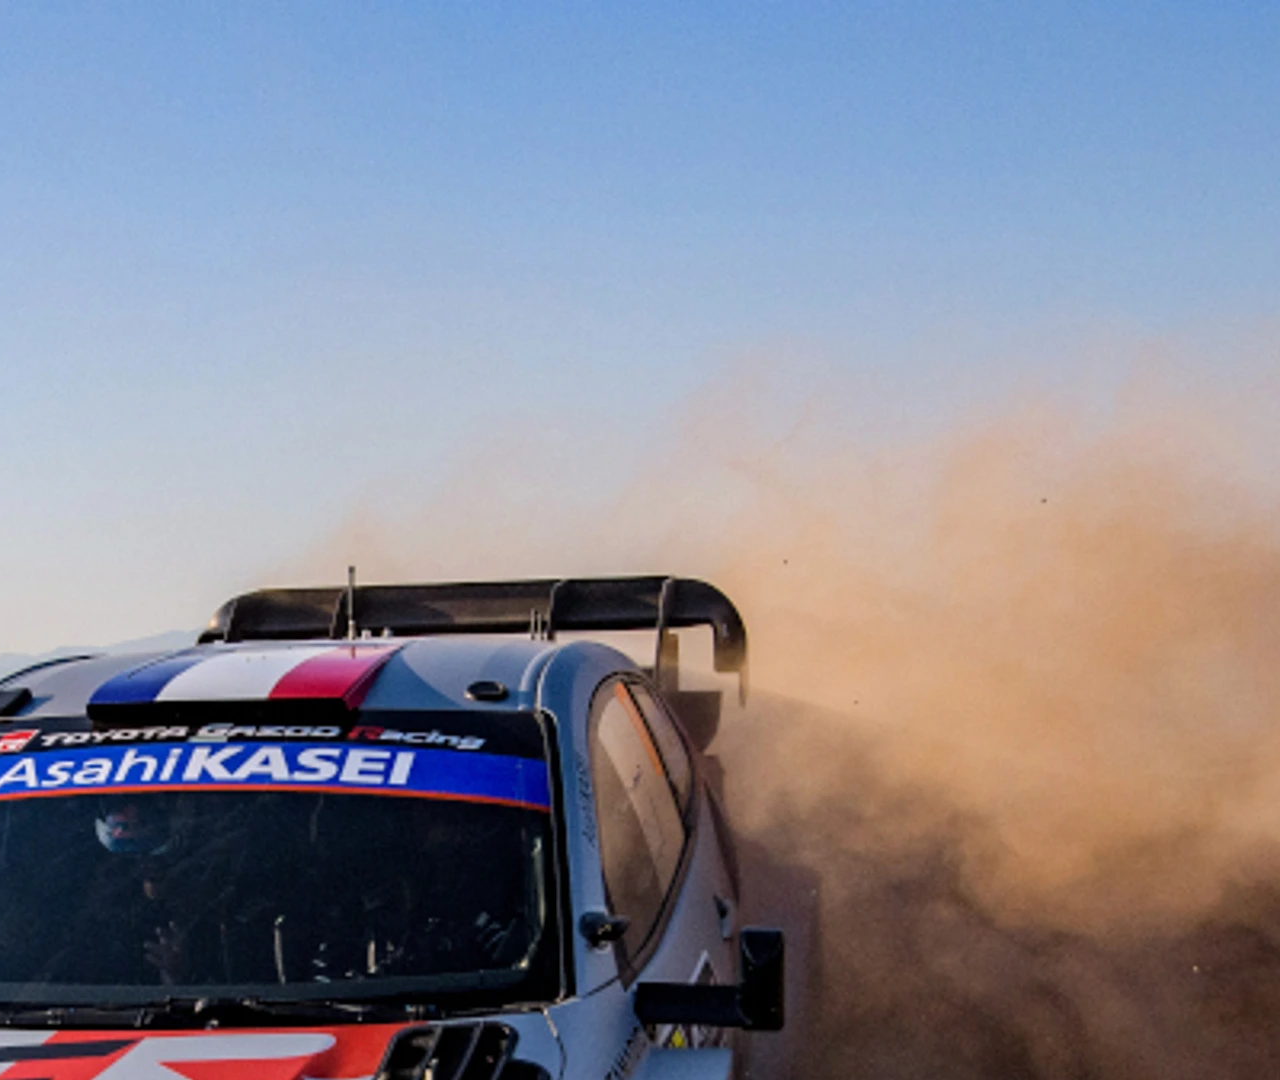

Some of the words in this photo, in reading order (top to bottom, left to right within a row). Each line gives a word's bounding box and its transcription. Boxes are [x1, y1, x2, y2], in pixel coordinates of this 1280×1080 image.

[41, 725, 189, 747] TOYOTA
[188, 723, 341, 743] GAZOO
[347, 725, 487, 750] Racing
